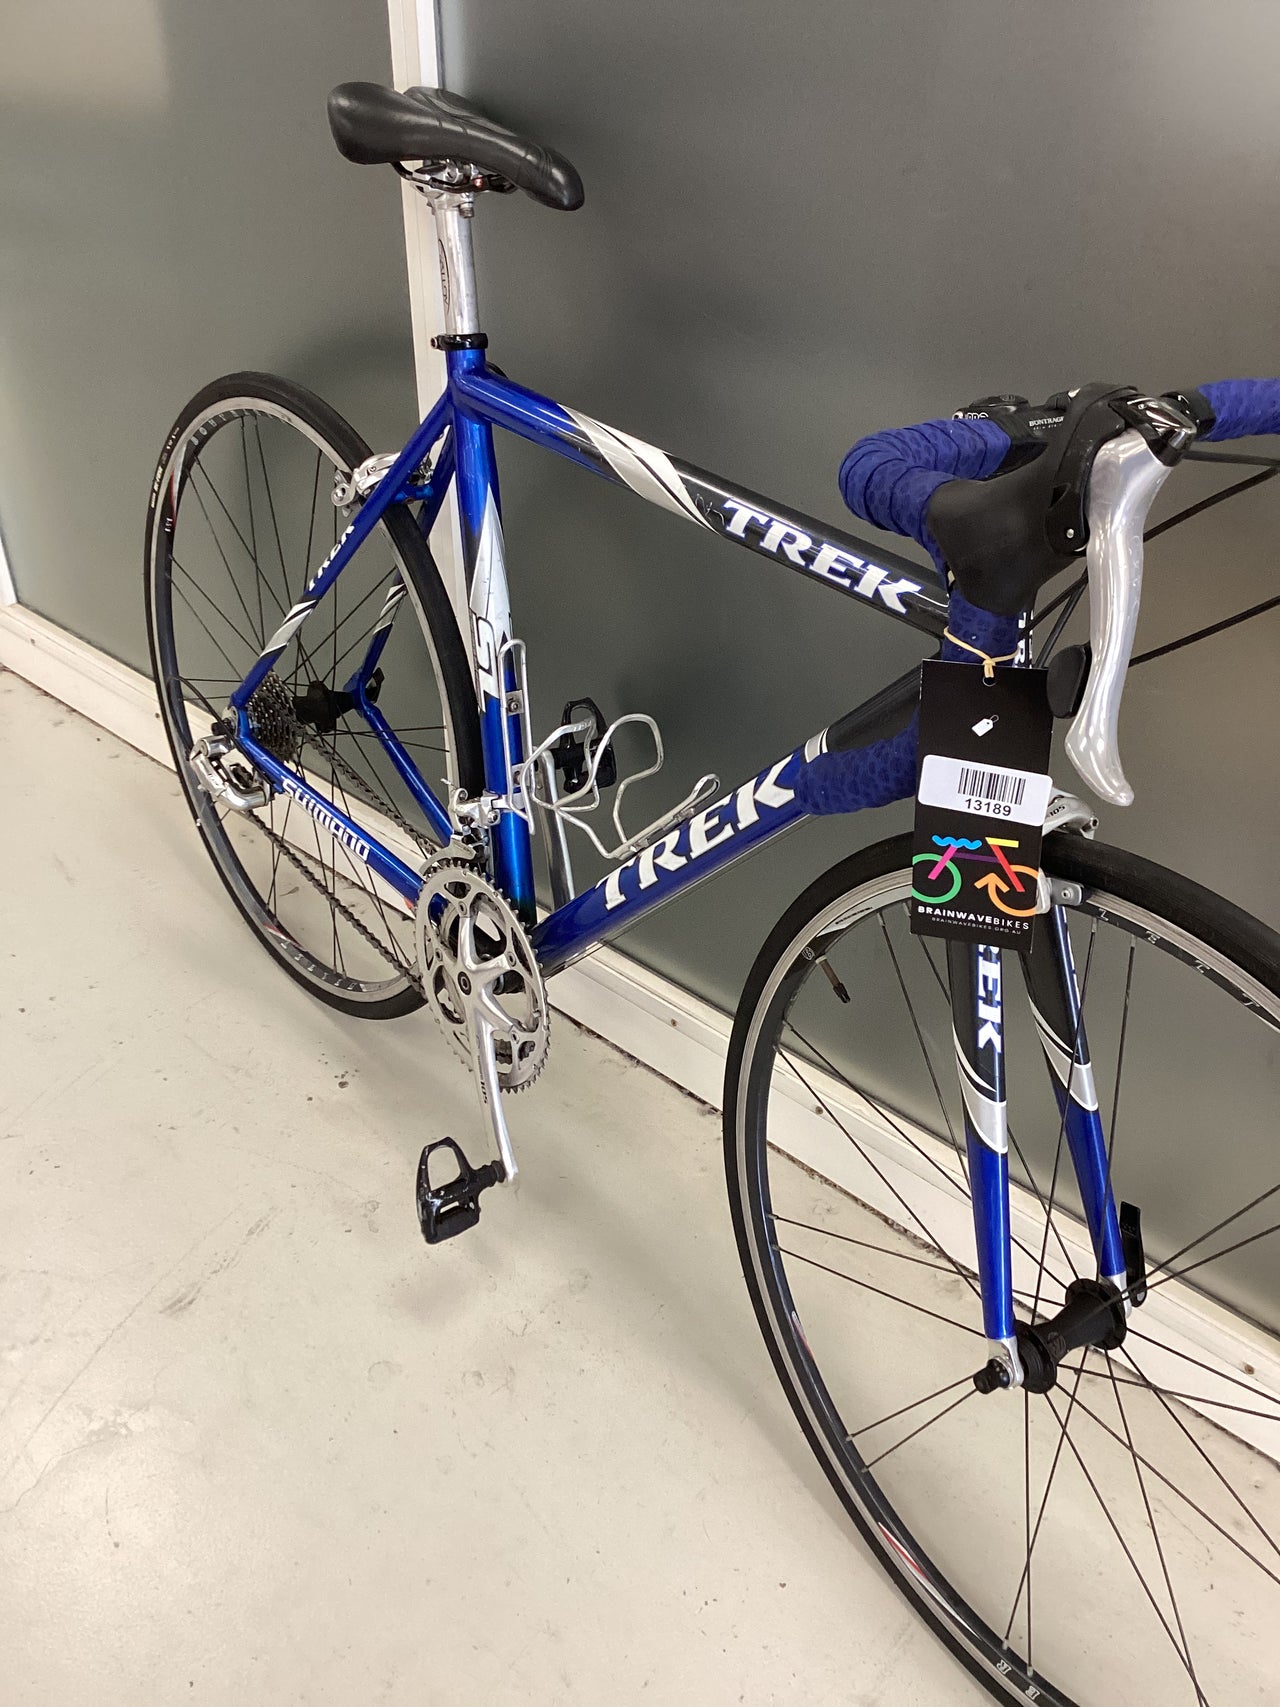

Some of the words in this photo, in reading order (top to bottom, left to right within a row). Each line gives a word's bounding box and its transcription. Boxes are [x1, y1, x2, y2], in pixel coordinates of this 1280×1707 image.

[723, 499, 922, 614] TREK
[595, 754, 796, 911] TREK
[965, 798, 1012, 817] 13189
[917, 905, 1030, 930] BRAINWAVEBIKES
[977, 944, 1002, 1054] EK
